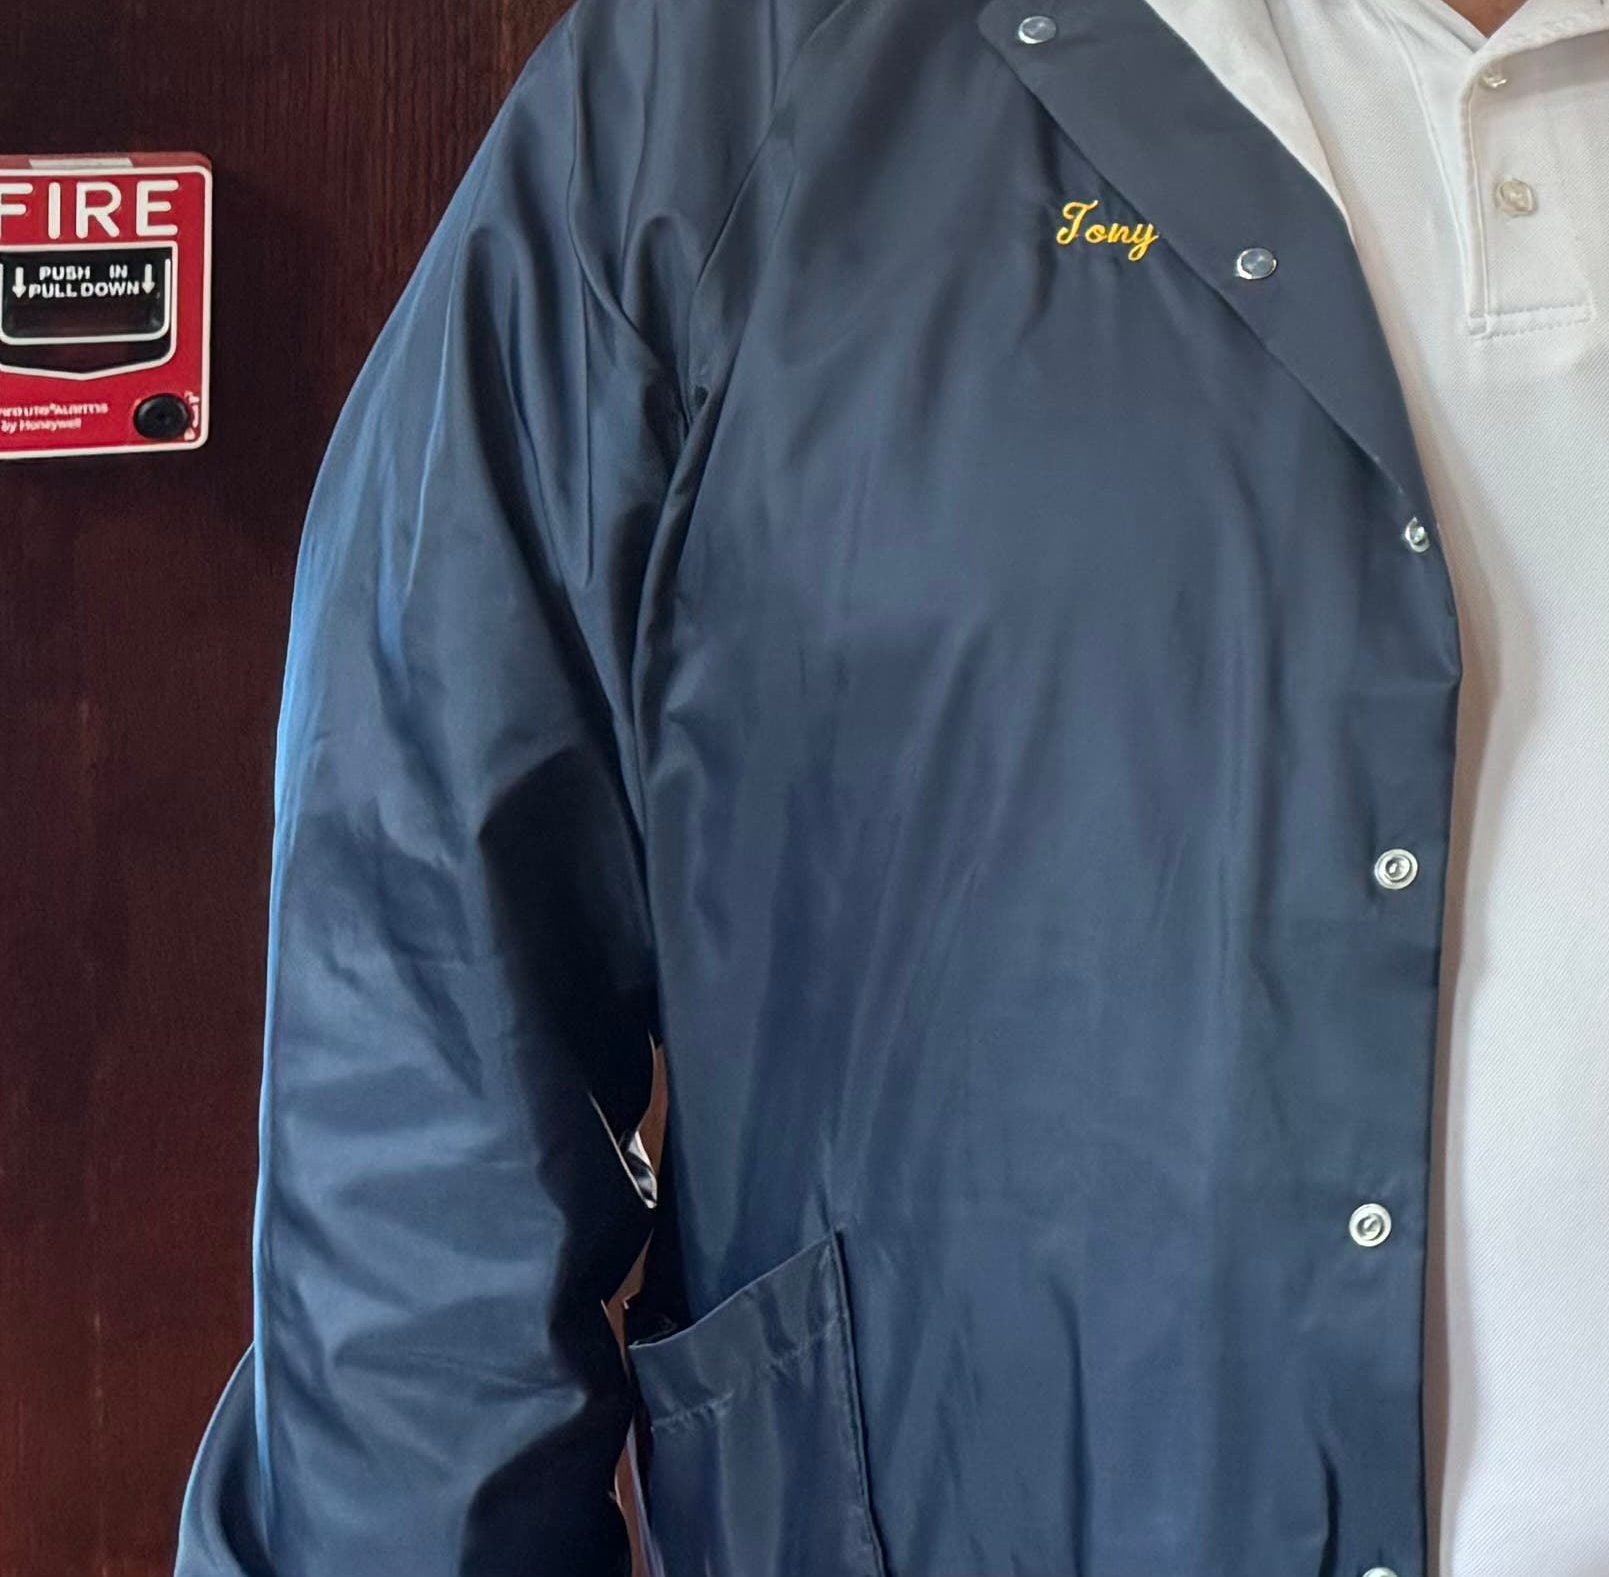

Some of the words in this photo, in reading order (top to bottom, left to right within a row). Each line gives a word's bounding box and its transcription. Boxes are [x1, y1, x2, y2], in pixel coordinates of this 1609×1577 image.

[0, 179, 180, 240] FIRE
[1056, 199, 1159, 262] Tony
[29, 282, 77, 299] PULL
[81, 280, 140, 298] DOWN
[39, 265, 91, 281] PUSH
[109, 264, 129, 279] IN
